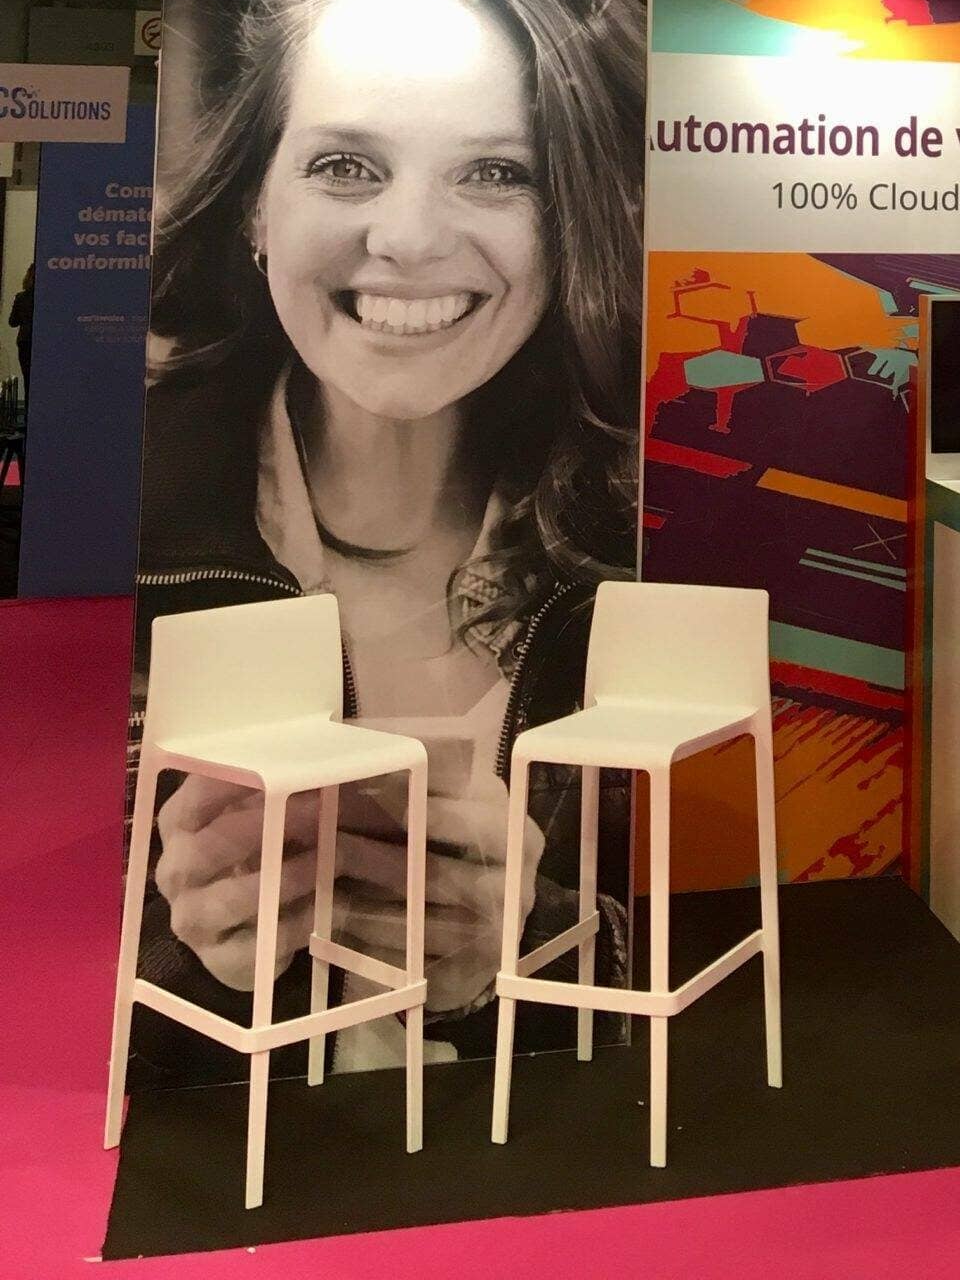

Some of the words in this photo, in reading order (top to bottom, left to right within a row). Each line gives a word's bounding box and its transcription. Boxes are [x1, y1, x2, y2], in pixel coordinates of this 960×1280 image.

[649, 114, 880, 157] utomation
[894, 116, 943, 157] de
[772, 182, 858, 210] 100%
[73, 233, 110, 246] vos
